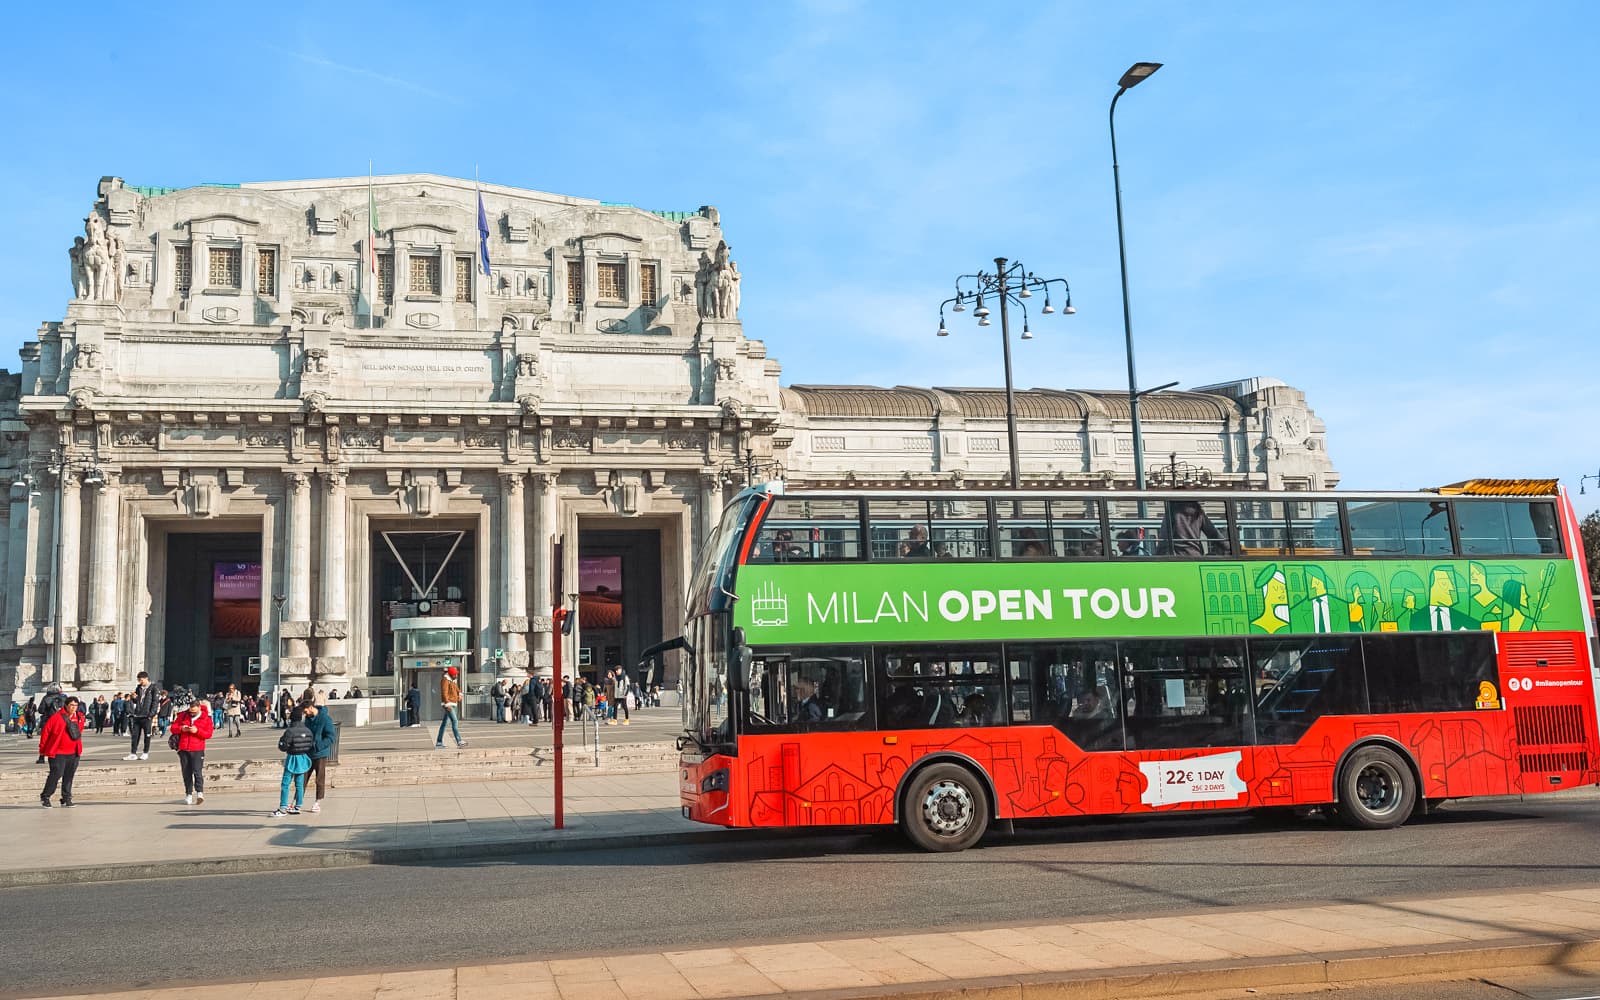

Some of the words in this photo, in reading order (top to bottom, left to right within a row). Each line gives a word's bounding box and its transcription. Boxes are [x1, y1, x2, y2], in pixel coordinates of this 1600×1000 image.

[807, 590, 929, 625] MILAN
[938, 589, 1053, 622] OPEN
[1063, 587, 1177, 620] TOUR
[1166, 769, 1194, 785] 22€
[1204, 770, 1225, 781] DAY
